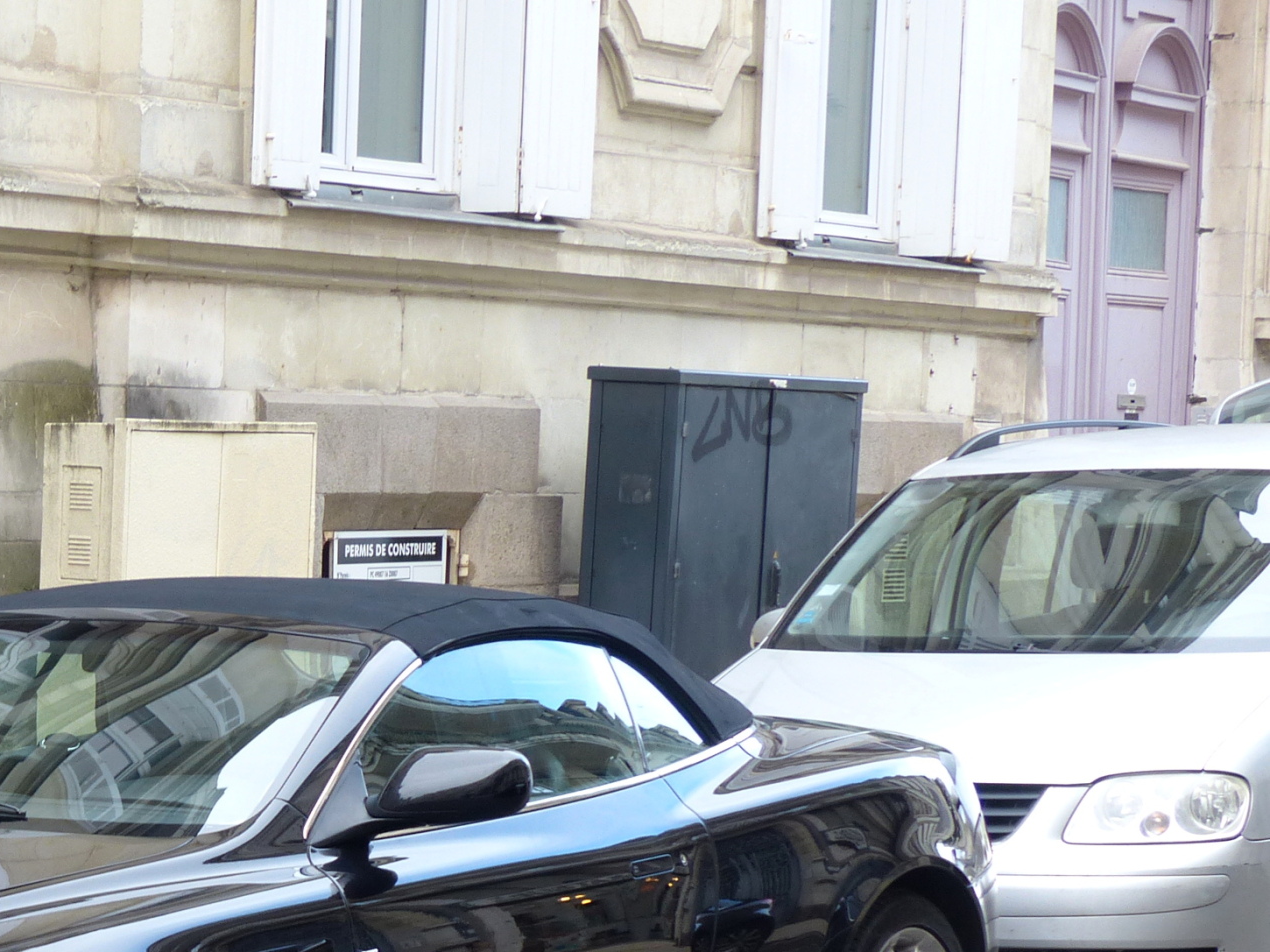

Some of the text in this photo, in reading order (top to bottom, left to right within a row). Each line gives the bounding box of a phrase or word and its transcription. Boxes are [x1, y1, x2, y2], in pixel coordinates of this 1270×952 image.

[344, 541, 437, 558] PERMIS DE CONSTRUIRE
